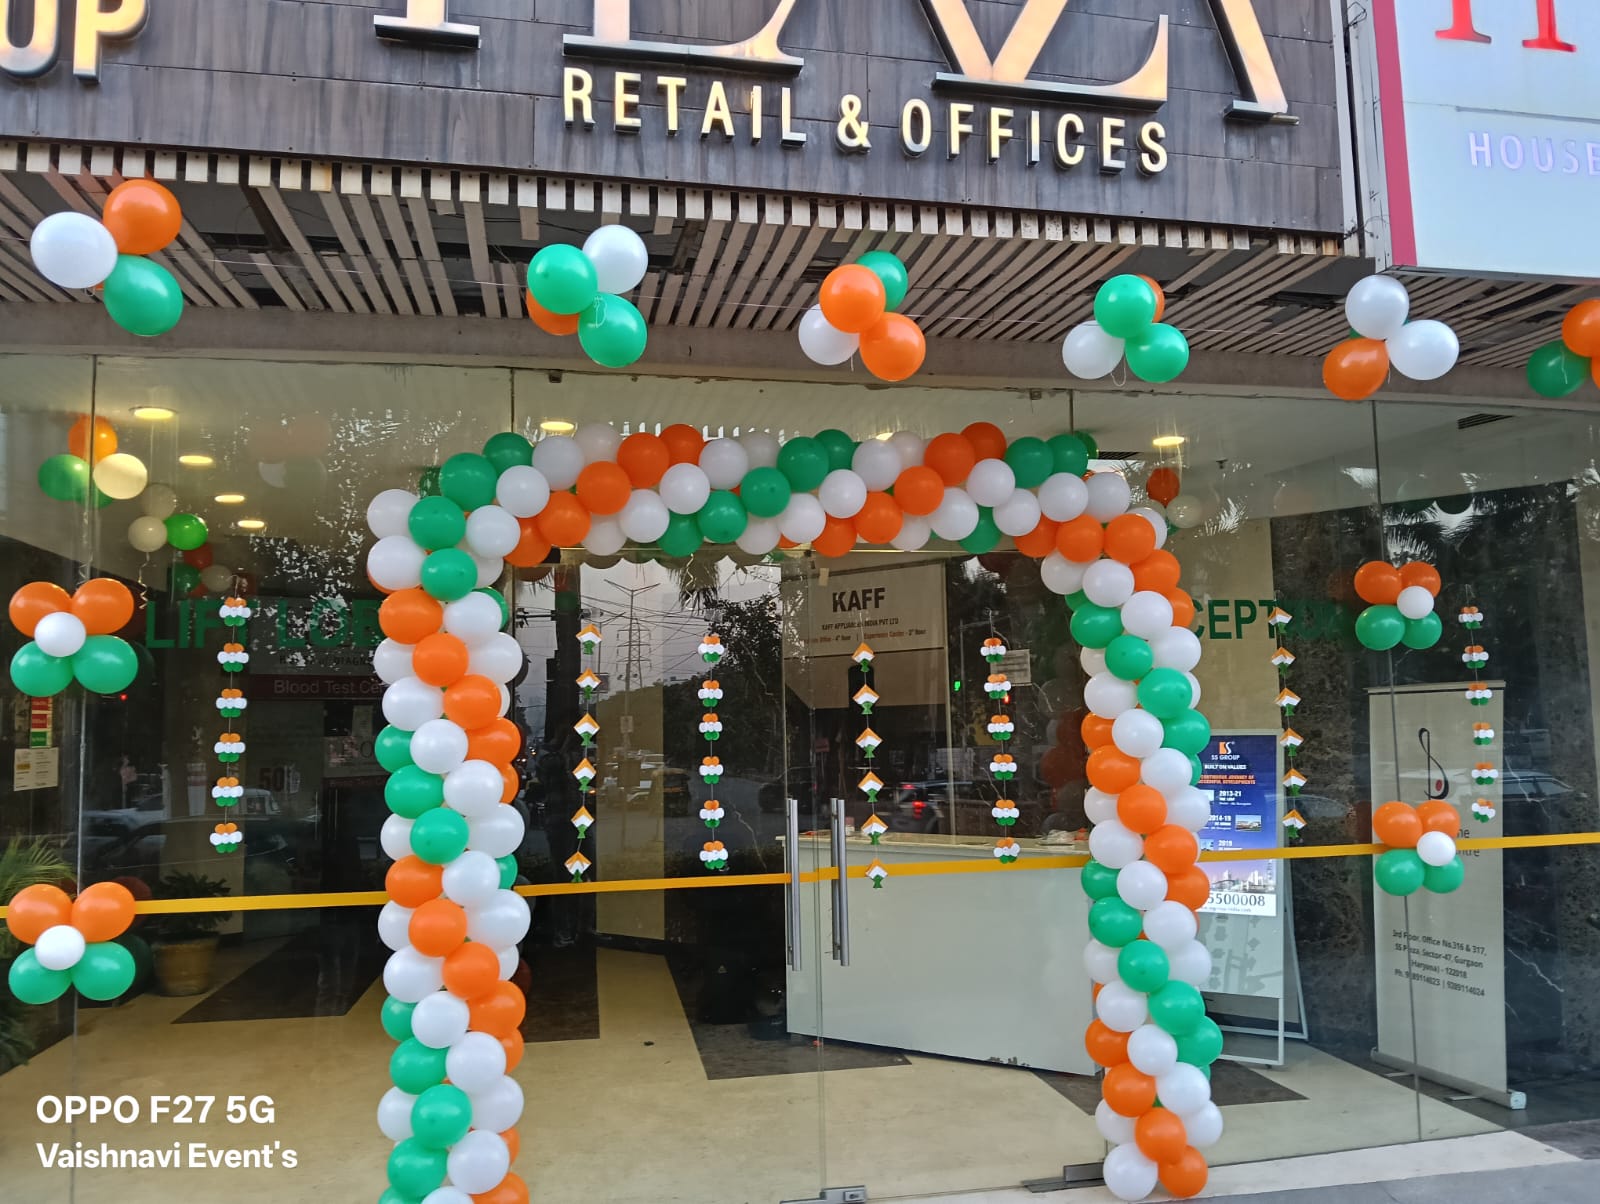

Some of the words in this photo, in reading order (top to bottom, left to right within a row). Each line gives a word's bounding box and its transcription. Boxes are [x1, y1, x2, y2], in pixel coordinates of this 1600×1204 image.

[563, 67, 807, 144] RETAIL
[836, 94, 872, 150] &
[901, 98, 1168, 175] OFFICES
[1468, 131, 1600, 177] HOUSE
[832, 587, 885, 612] KAFF
[879, 618, 888, 626] PVT
[274, 680, 320, 694] Blood
[323, 680, 357, 694] Test
[1422, 935, 1440, 946] Office
[1454, 956, 1484, 968] Gurgaon
